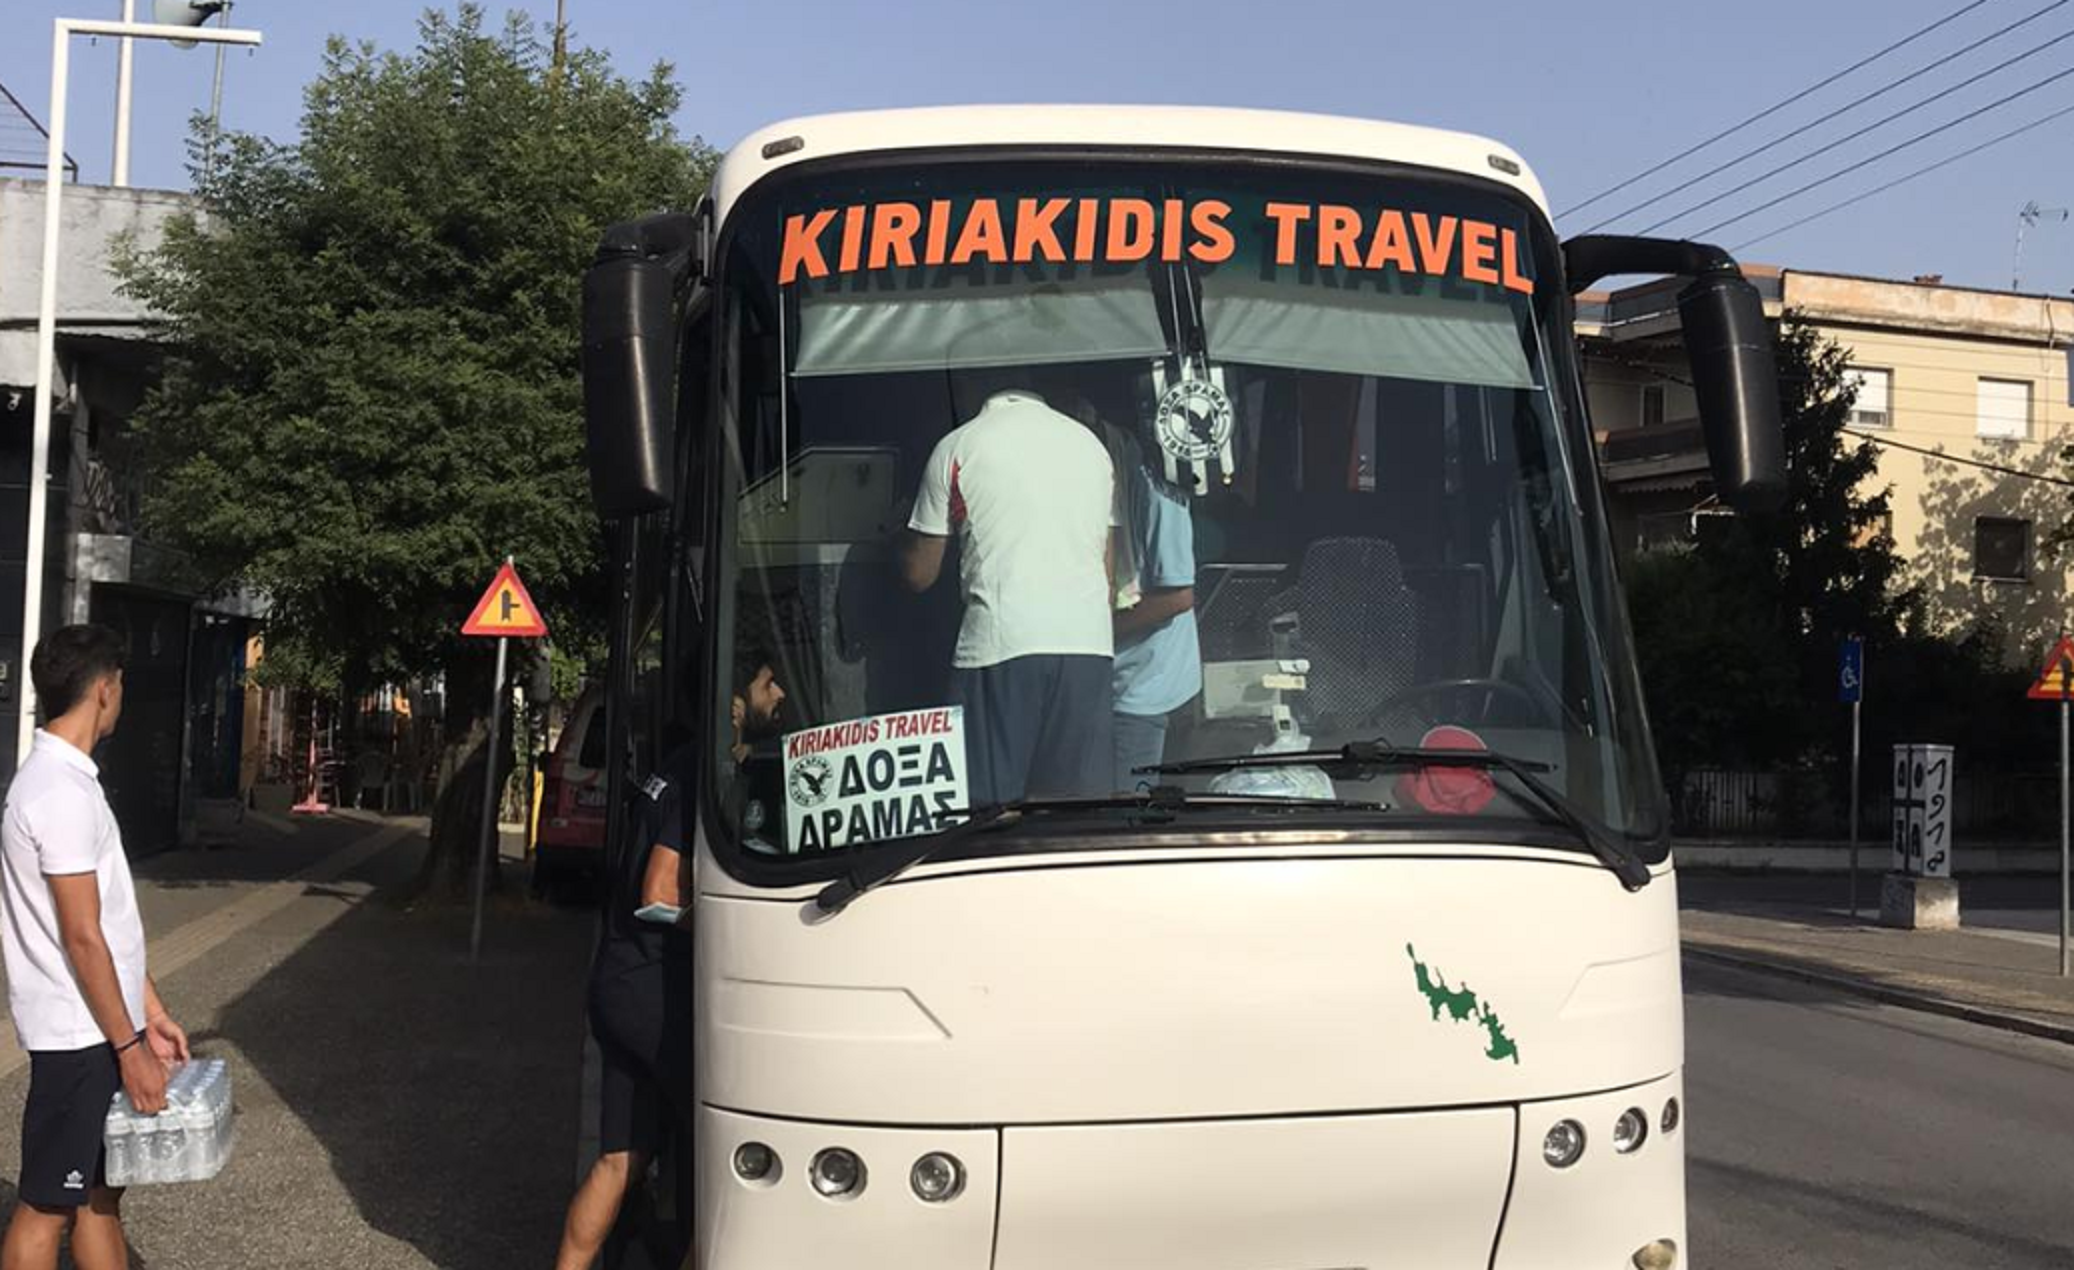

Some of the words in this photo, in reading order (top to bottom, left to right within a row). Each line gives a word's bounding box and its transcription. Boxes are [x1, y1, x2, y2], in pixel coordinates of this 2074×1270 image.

[778, 197, 1236, 284] KIRIAKIDIS
[1265, 202, 1534, 294] TRAVEL
[788, 719, 880, 759] KIRIAKIDIS
[885, 710, 953, 739] TRAVEL
[838, 741, 955, 798] ΔΟΞΑ
[799, 790, 958, 850] ΔΡΑΜΑΣ
